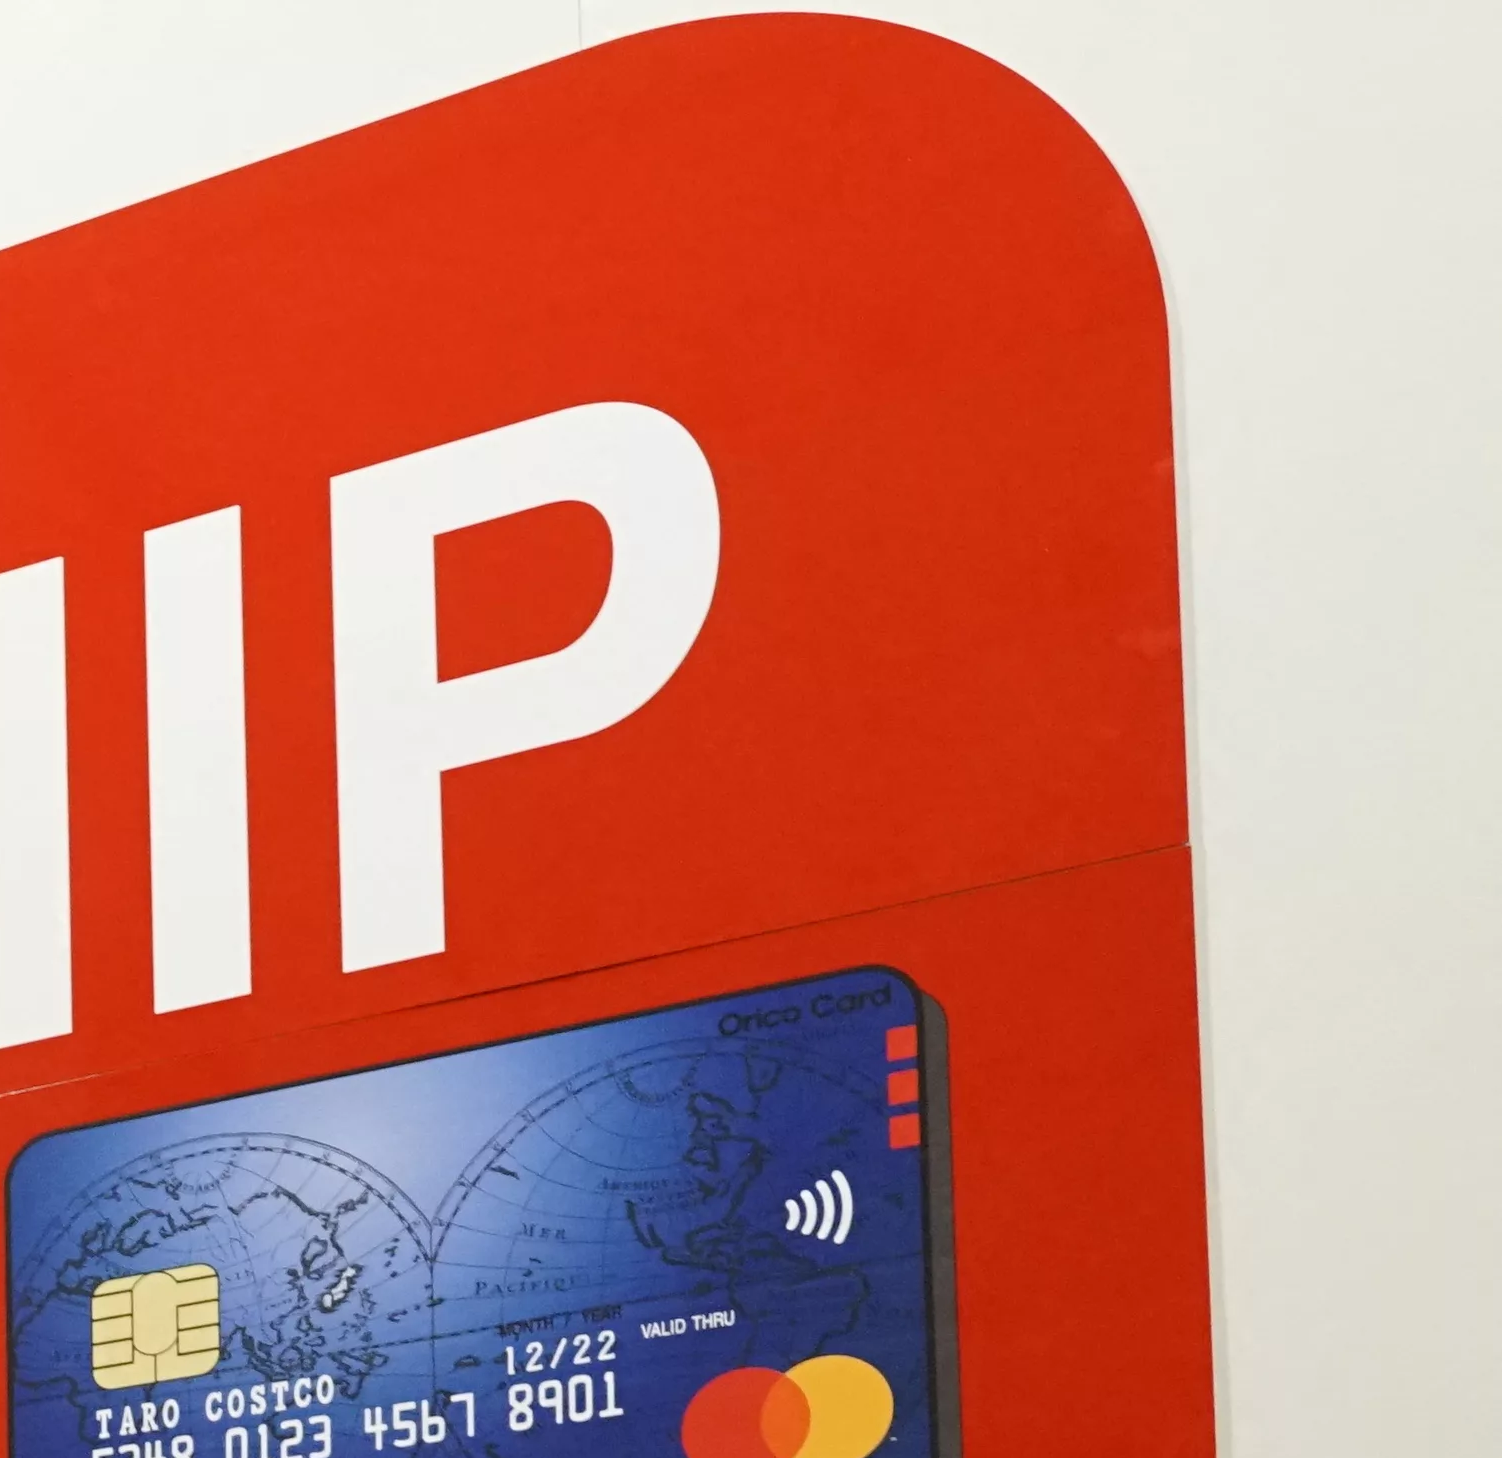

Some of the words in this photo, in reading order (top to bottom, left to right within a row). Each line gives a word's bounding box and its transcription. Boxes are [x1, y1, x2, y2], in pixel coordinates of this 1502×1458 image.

[718, 1004, 801, 1038] Orico
[810, 983, 892, 1019] Card
[640, 1317, 687, 1340] VALID
[691, 1308, 736, 1334] THRU
[505, 1329, 617, 1375] 12/22
[96, 1398, 180, 1440] TARO
[205, 1374, 335, 1422] COSTCO
[363, 1391, 476, 1451] 4567
[507, 1370, 624, 1432] 8901
